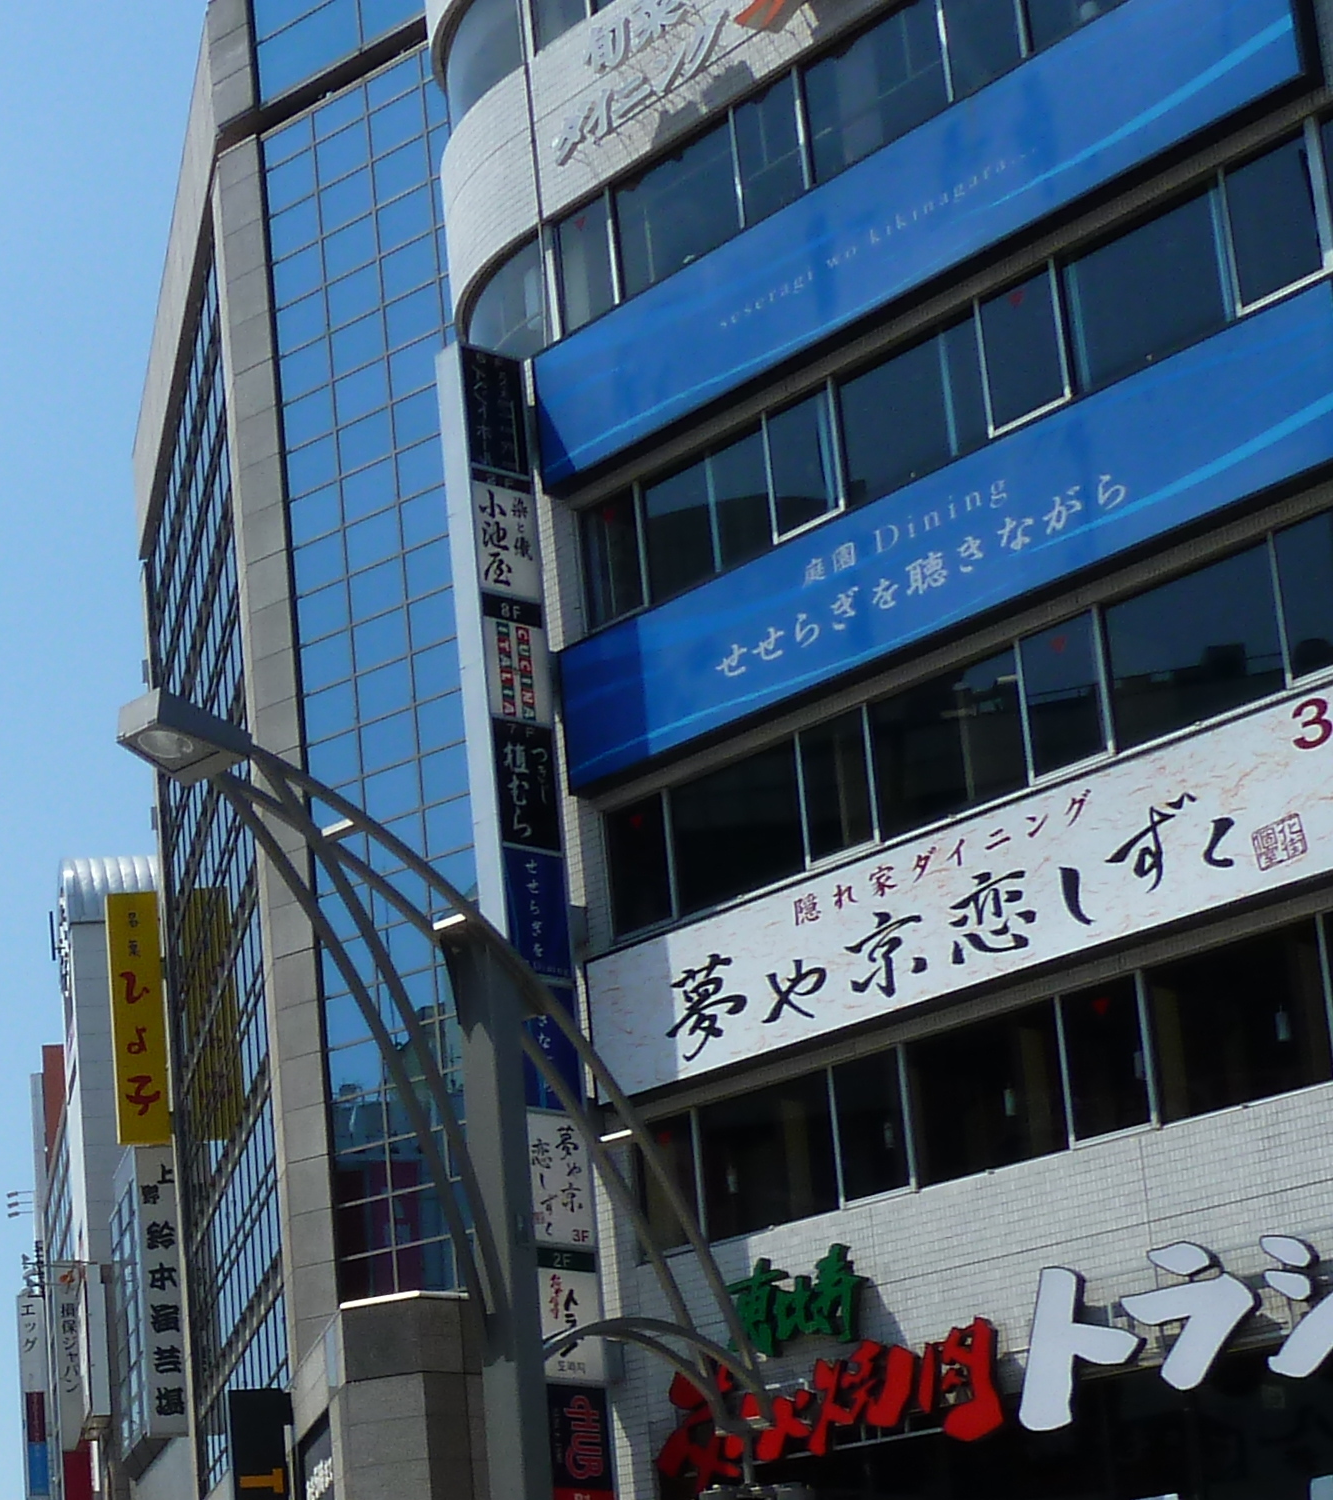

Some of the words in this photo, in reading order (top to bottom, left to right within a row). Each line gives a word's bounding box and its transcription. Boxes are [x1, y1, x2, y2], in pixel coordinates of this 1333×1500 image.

[478, 489, 513, 588] 小池屋
[873, 475, 1010, 552] Dining
[501, 603, 522, 619] 8F
[714, 472, 1130, 681] せせらぎを聴きながら
[496, 622, 518, 717] ITALIA
[515, 627, 538, 721] CUCINA
[793, 789, 1093, 927] 隠れ家ダイニング
[119, 970, 162, 1117] ひよ子
[553, 1252, 573, 1268] 2F
[571, 1228, 591, 1243] 3F
[20, 1304, 38, 1353] エッグ
[60, 1302, 81, 1394] 損保ジャパン
